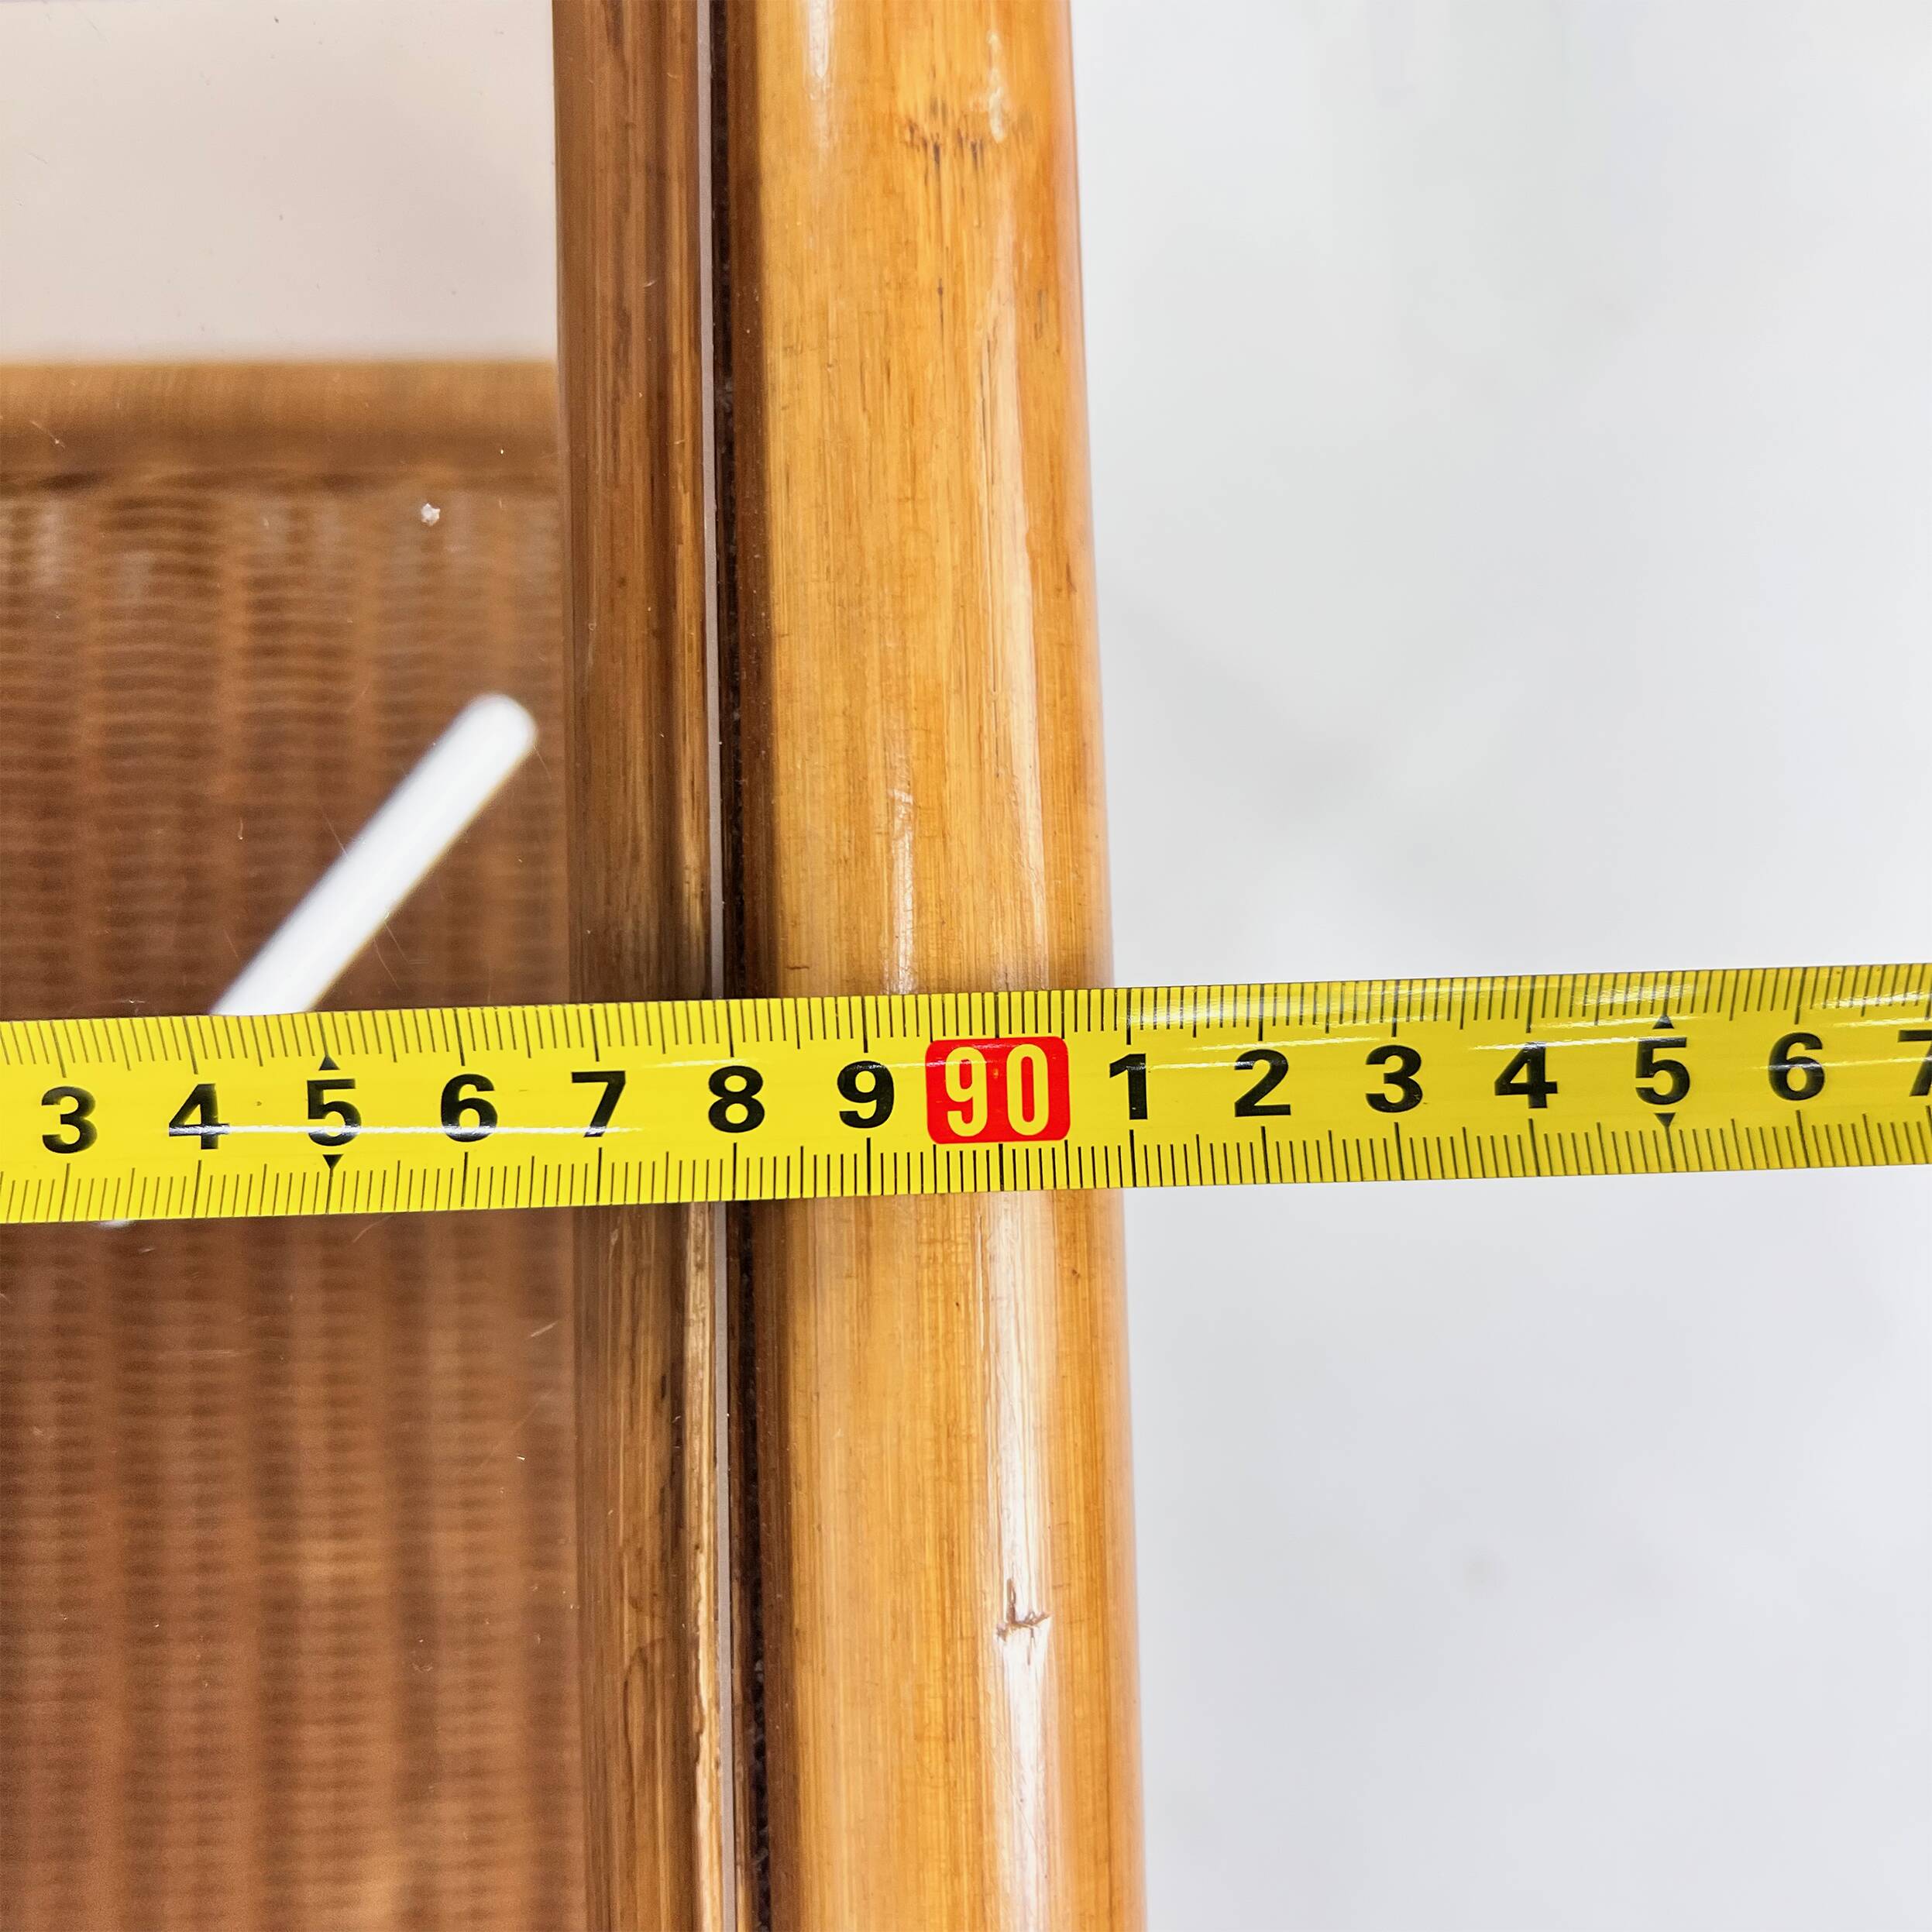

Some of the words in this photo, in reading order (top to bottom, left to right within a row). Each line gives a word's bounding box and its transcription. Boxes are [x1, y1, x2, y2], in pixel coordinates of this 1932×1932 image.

[42, 1086, 98, 1153] 3
[168, 1083, 229, 1150] 4
[307, 1078, 362, 1146] 5
[440, 1074, 498, 1143] 6
[571, 1071, 627, 1137] 7
[708, 1066, 765, 1133] 8
[837, 1061, 895, 1128] 9
[945, 1043, 1049, 1137] 90
[1109, 1054, 1150, 1120] 1
[1234, 1049, 1291, 1117] 2
[1366, 1045, 1423, 1112] 3
[1494, 1041, 1558, 1109] 4
[1635, 1036, 1690, 1105] 5
[1769, 1032, 1825, 1101] 6
